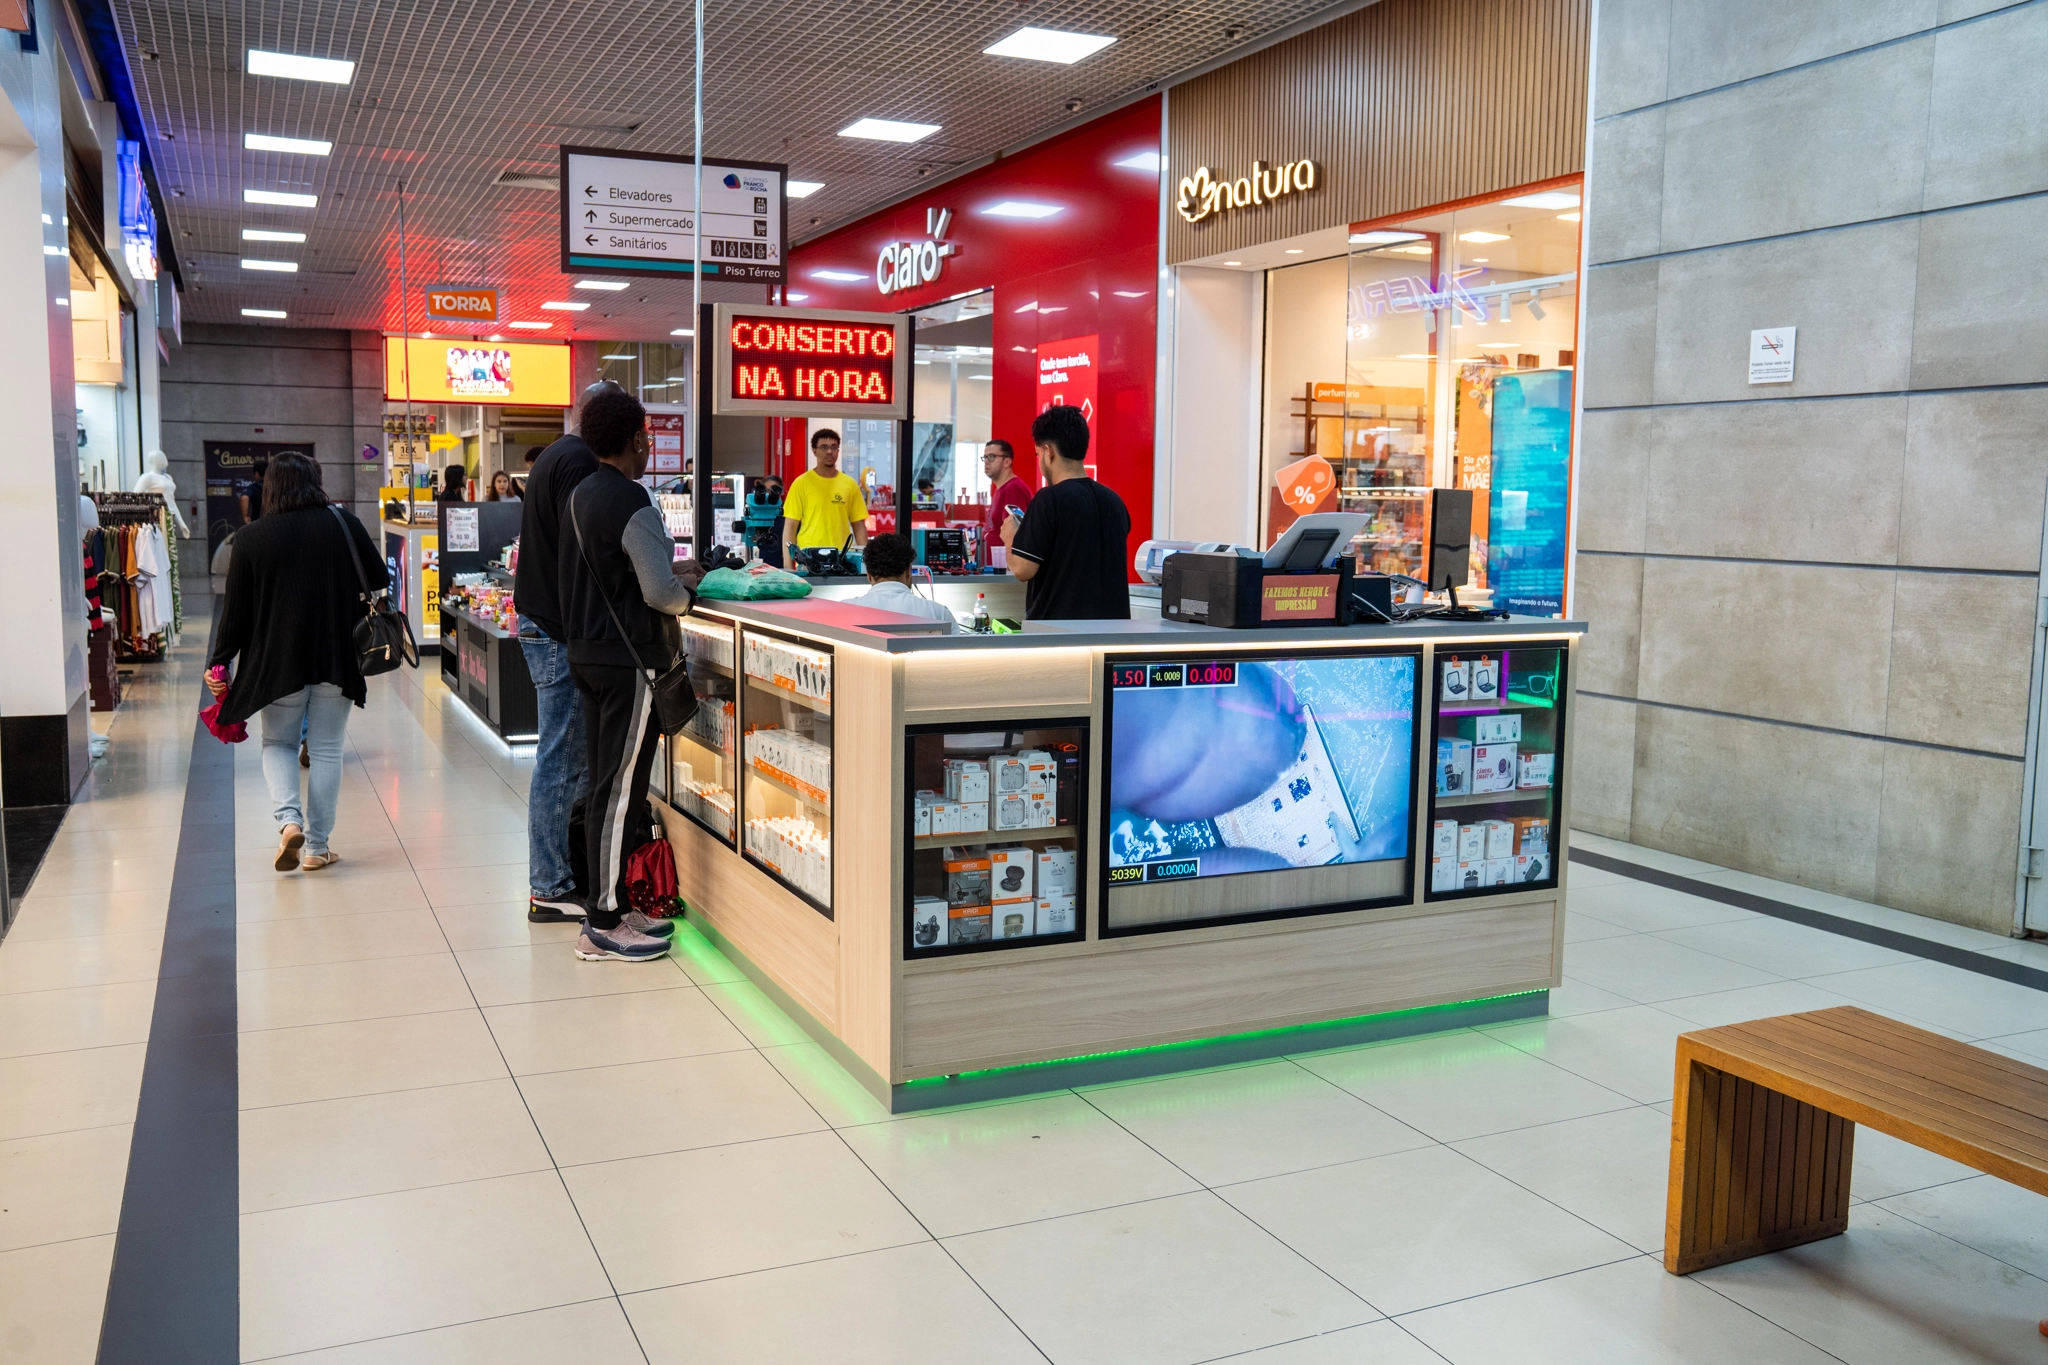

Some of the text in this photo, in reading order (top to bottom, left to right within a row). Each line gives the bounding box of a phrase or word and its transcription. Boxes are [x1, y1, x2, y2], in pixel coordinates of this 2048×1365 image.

[1213, 159, 1315, 213] natura
[609, 187, 673, 204] Elevadores
[609, 212, 694, 229] Supermercado
[609, 236, 667, 251] Sanitários
[725, 265, 780, 279] Piso Térreo
[877, 240, 942, 294] Claro
[432, 294, 493, 313] TORRA
[732, 323, 893, 356] CONSERTO
[1040, 352, 1091, 371] Onde tem torcida,
[739, 366, 887, 400] NA HORA
[1040, 370, 1069, 385] tem Claro.
[1463, 455, 1475, 464] Dia
[1463, 464, 1476, 472] das
[1264, 586, 1330, 598] FAZEMOS XEROX E
[1275, 597, 1317, 611] IMPRESSÃO
[1508, 597, 1537, 606] Imaginando
[1541, 599, 1560, 607] futuro.
[1189, 667, 1233, 683] 0.000
[1157, 862, 1197, 877] 0.0000A
